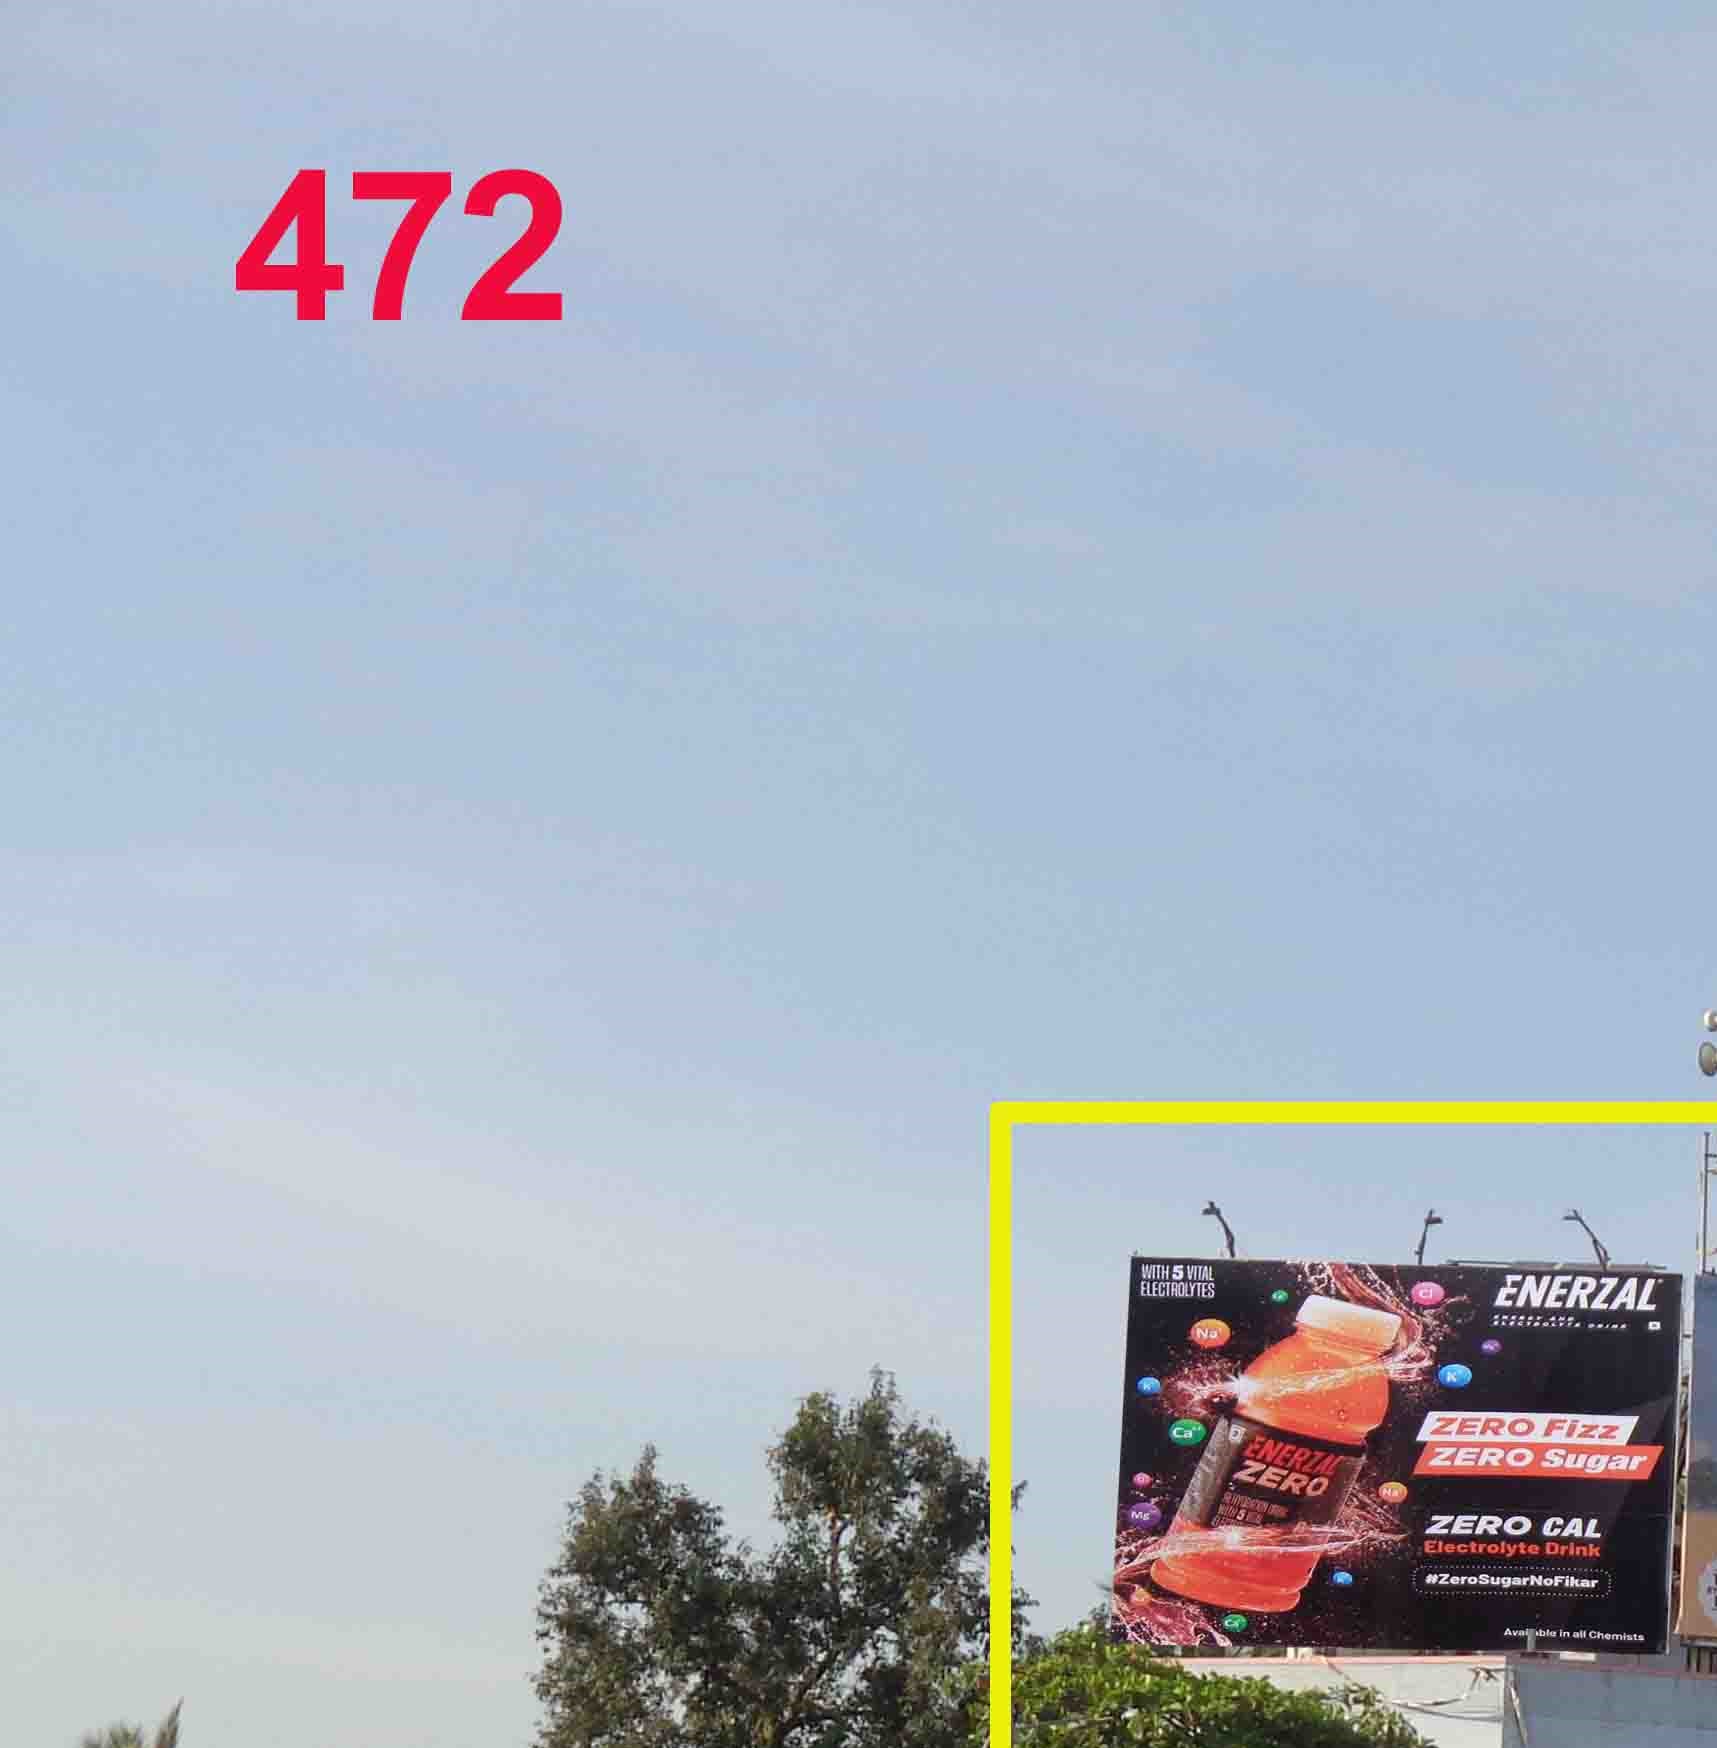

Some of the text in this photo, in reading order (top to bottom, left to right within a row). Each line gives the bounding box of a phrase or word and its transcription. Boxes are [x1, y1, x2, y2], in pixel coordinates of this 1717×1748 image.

[1141, 1264, 1214, 1281] WITH 5 VITAL
[1141, 1281, 1215, 1298] ELECTROLYTES
[1494, 1275, 1660, 1312] ENERZAL
[1429, 1417, 1619, 1440] ZERO Fizz
[1428, 1447, 1649, 1473] ZERO Sugar
[1233, 1459, 1330, 1497] ZERO
[1424, 1515, 1601, 1538] ZERO CAL
[1424, 1540, 1601, 1557] Electrolyte Drink
[1425, 1573, 1599, 1589] #ZeroSugarNoFikar
[1503, 1627, 1645, 1642] Avaiable in all Chemists
